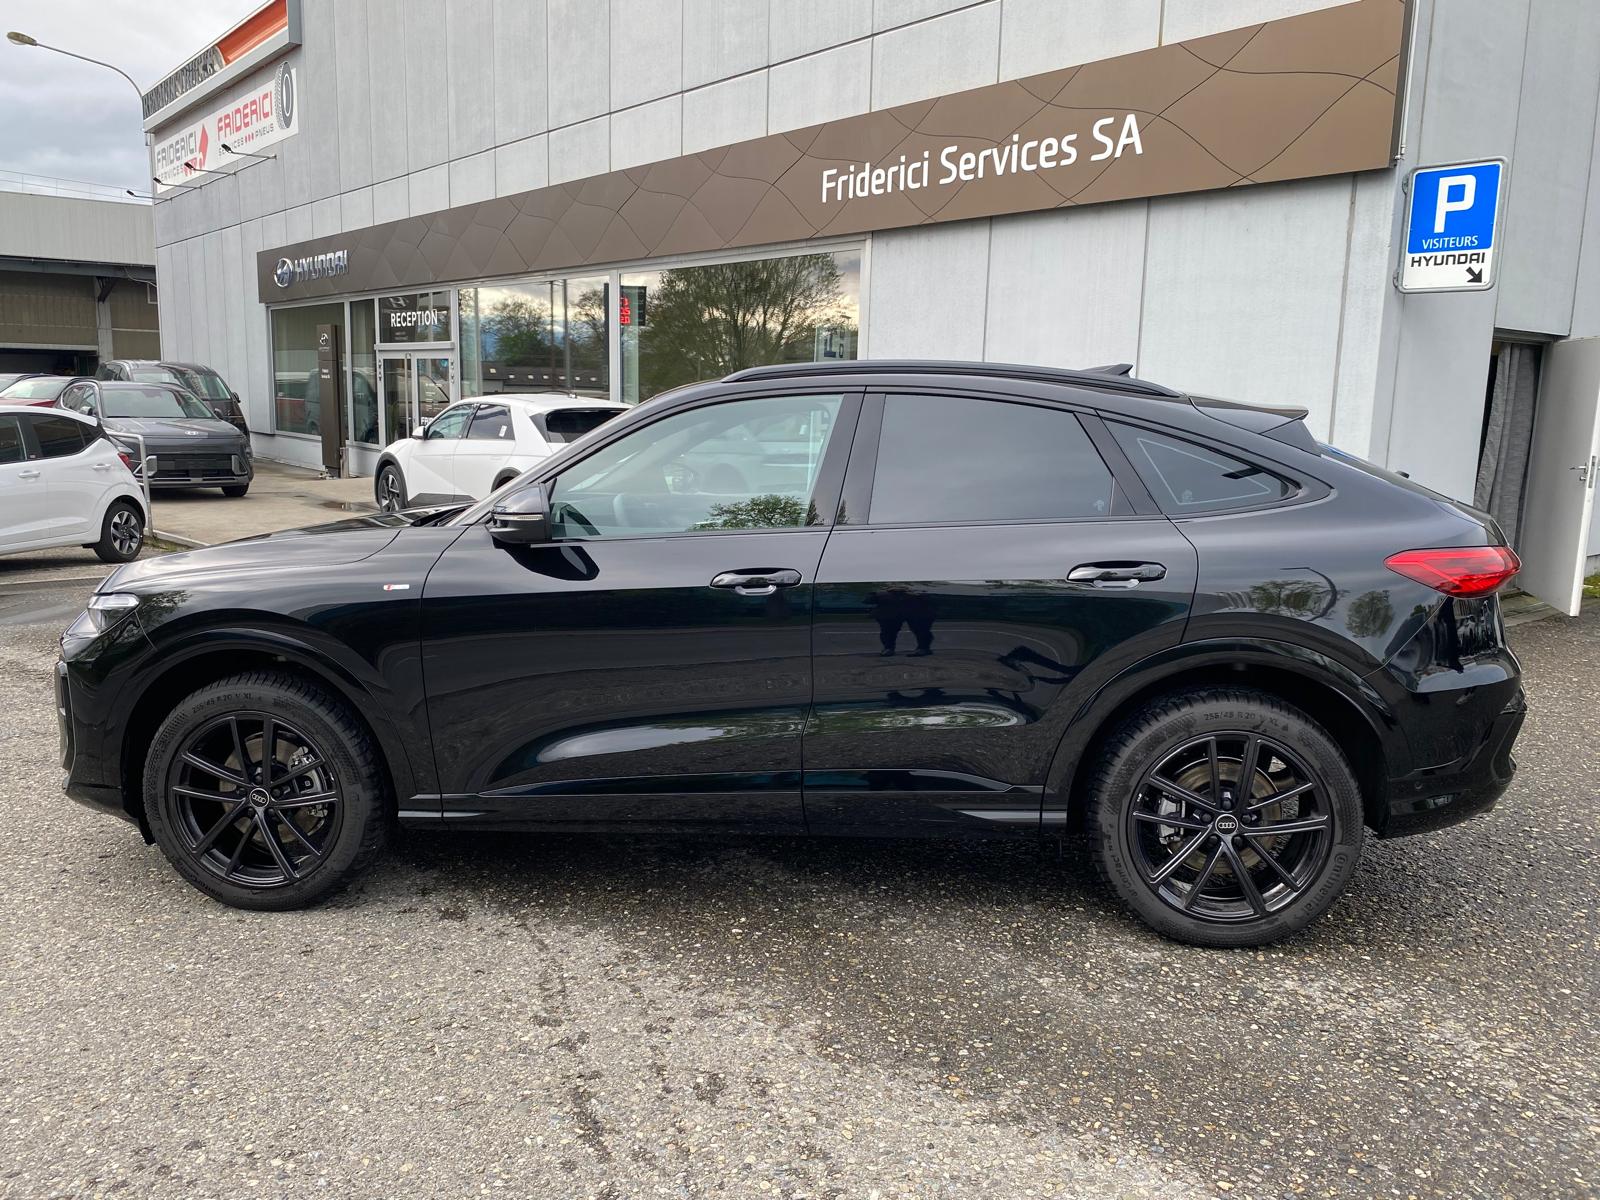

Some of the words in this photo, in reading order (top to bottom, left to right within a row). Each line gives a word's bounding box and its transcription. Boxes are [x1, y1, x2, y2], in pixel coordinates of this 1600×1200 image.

[217, 91, 272, 141] FRIDERICI
[255, 123, 274, 137] PNEUS
[156, 130, 197, 171] FRIDERICI
[821, 150, 929, 203] Friderici
[939, 133, 1078, 185] Services
[1090, 113, 1144, 162] SA
[1434, 174, 1477, 234] P
[1422, 235, 1479, 250] VISITEURS
[294, 249, 348, 282] HYUNDAI
[1410, 252, 1486, 268] HYUNDAI
[390, 309, 438, 328] RECEPTION
